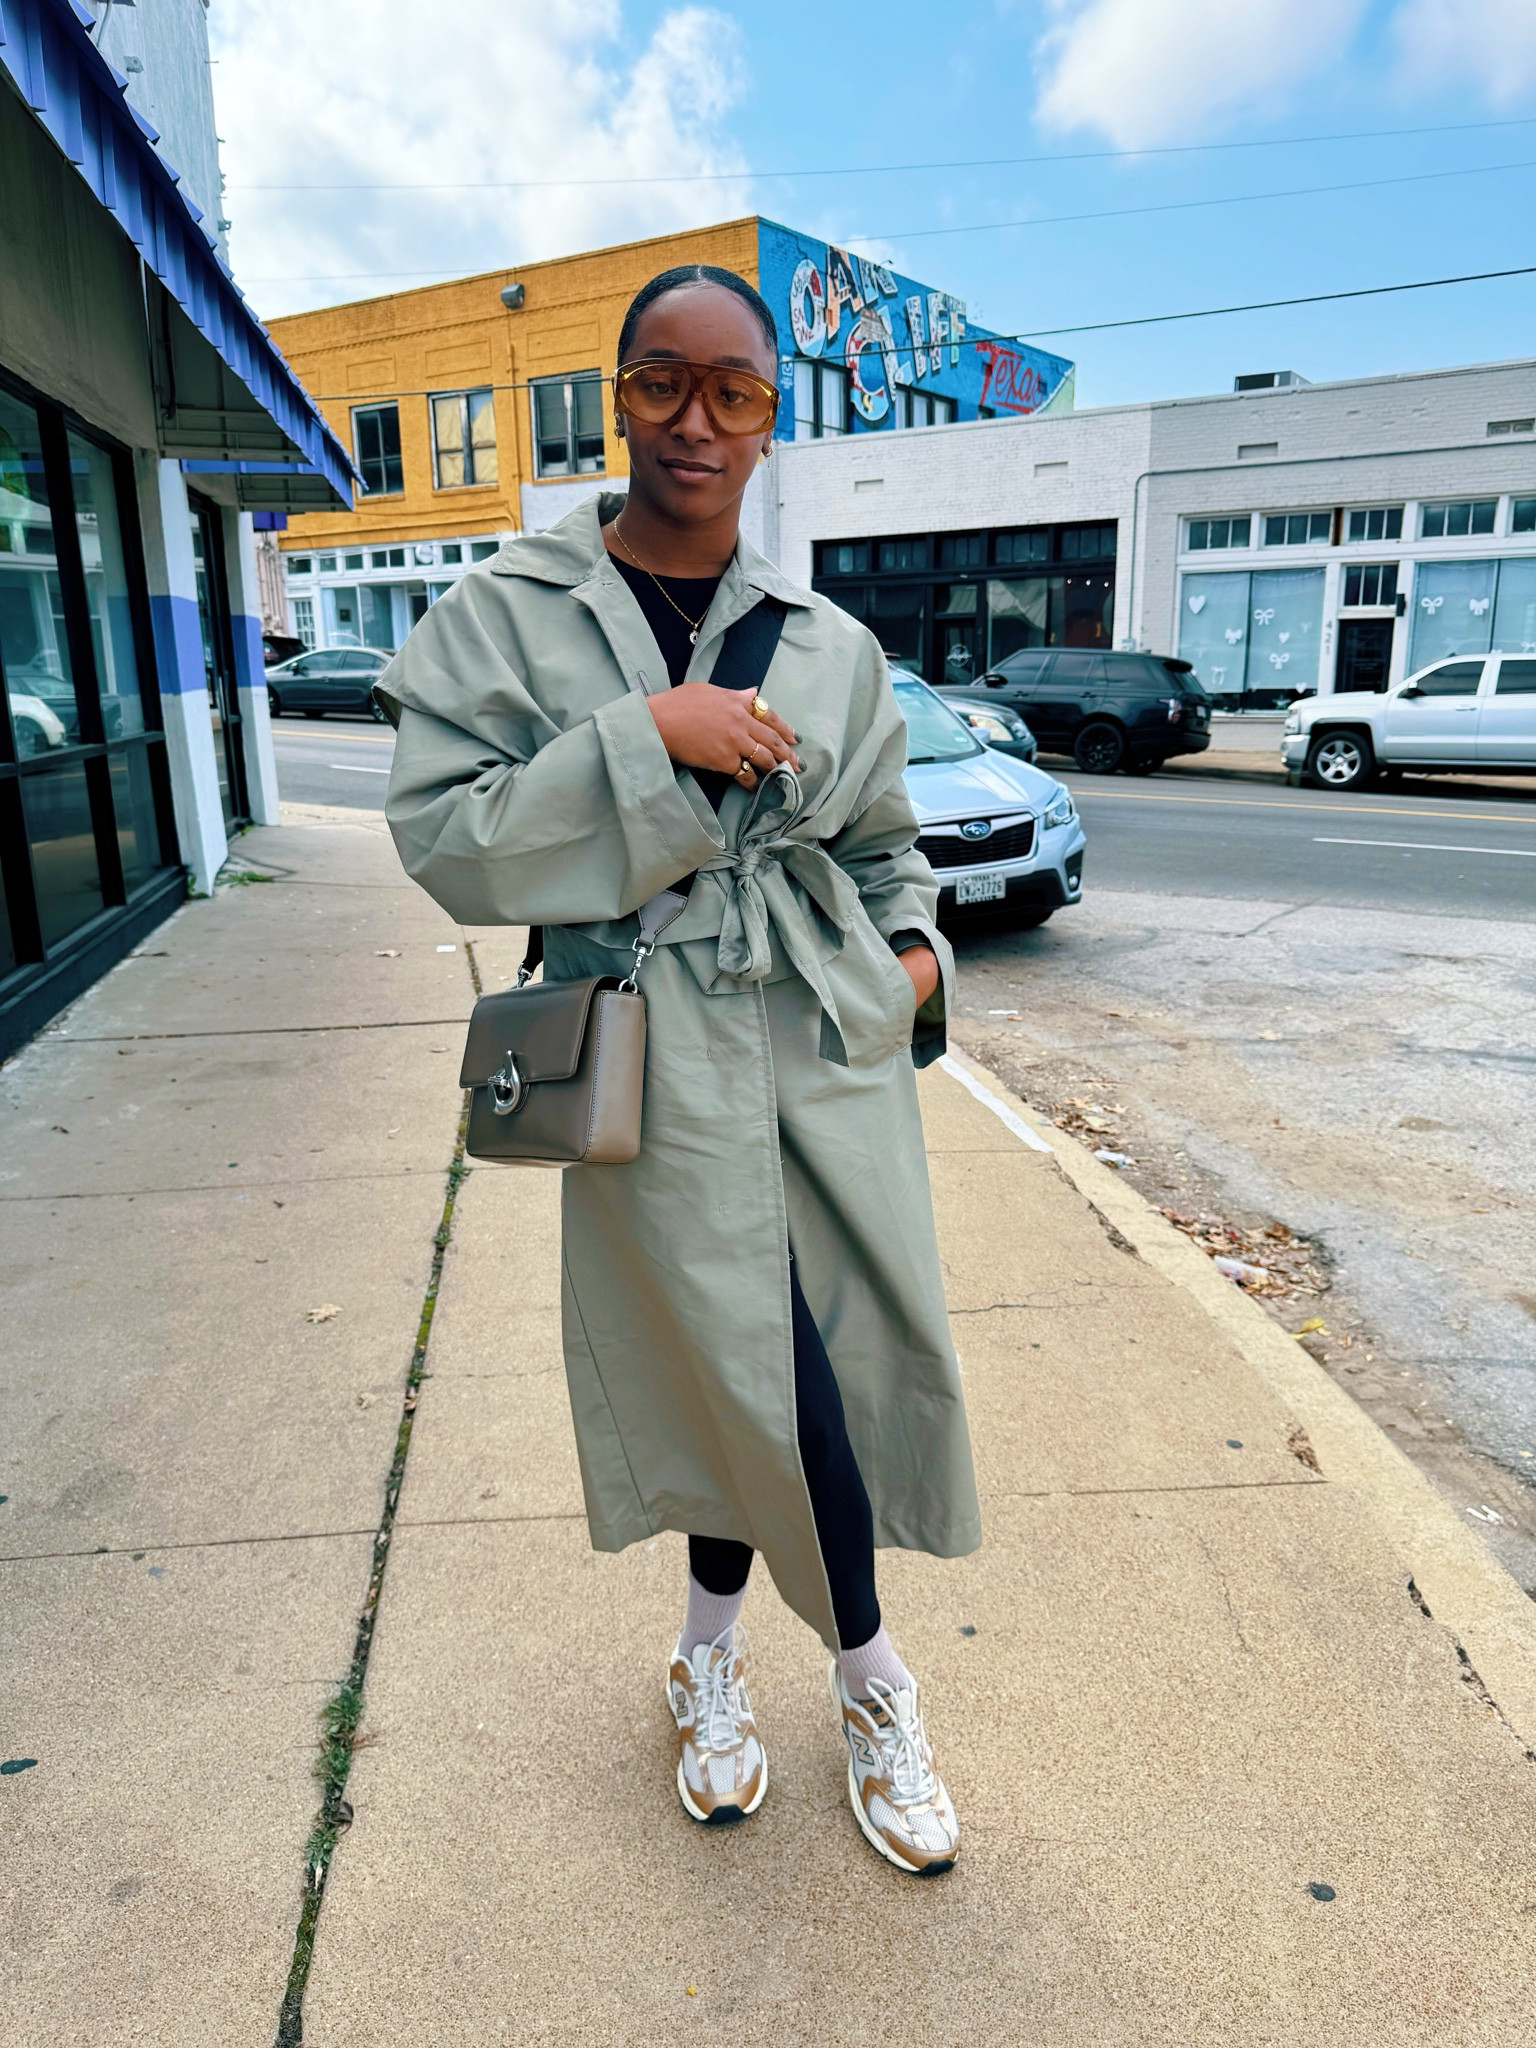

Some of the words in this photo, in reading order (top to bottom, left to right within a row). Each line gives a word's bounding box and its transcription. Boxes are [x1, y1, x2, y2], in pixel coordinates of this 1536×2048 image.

[790, 244, 898, 357] OAK
[845, 291, 966, 421] CLIFF
[975, 342, 1043, 407] Texas
